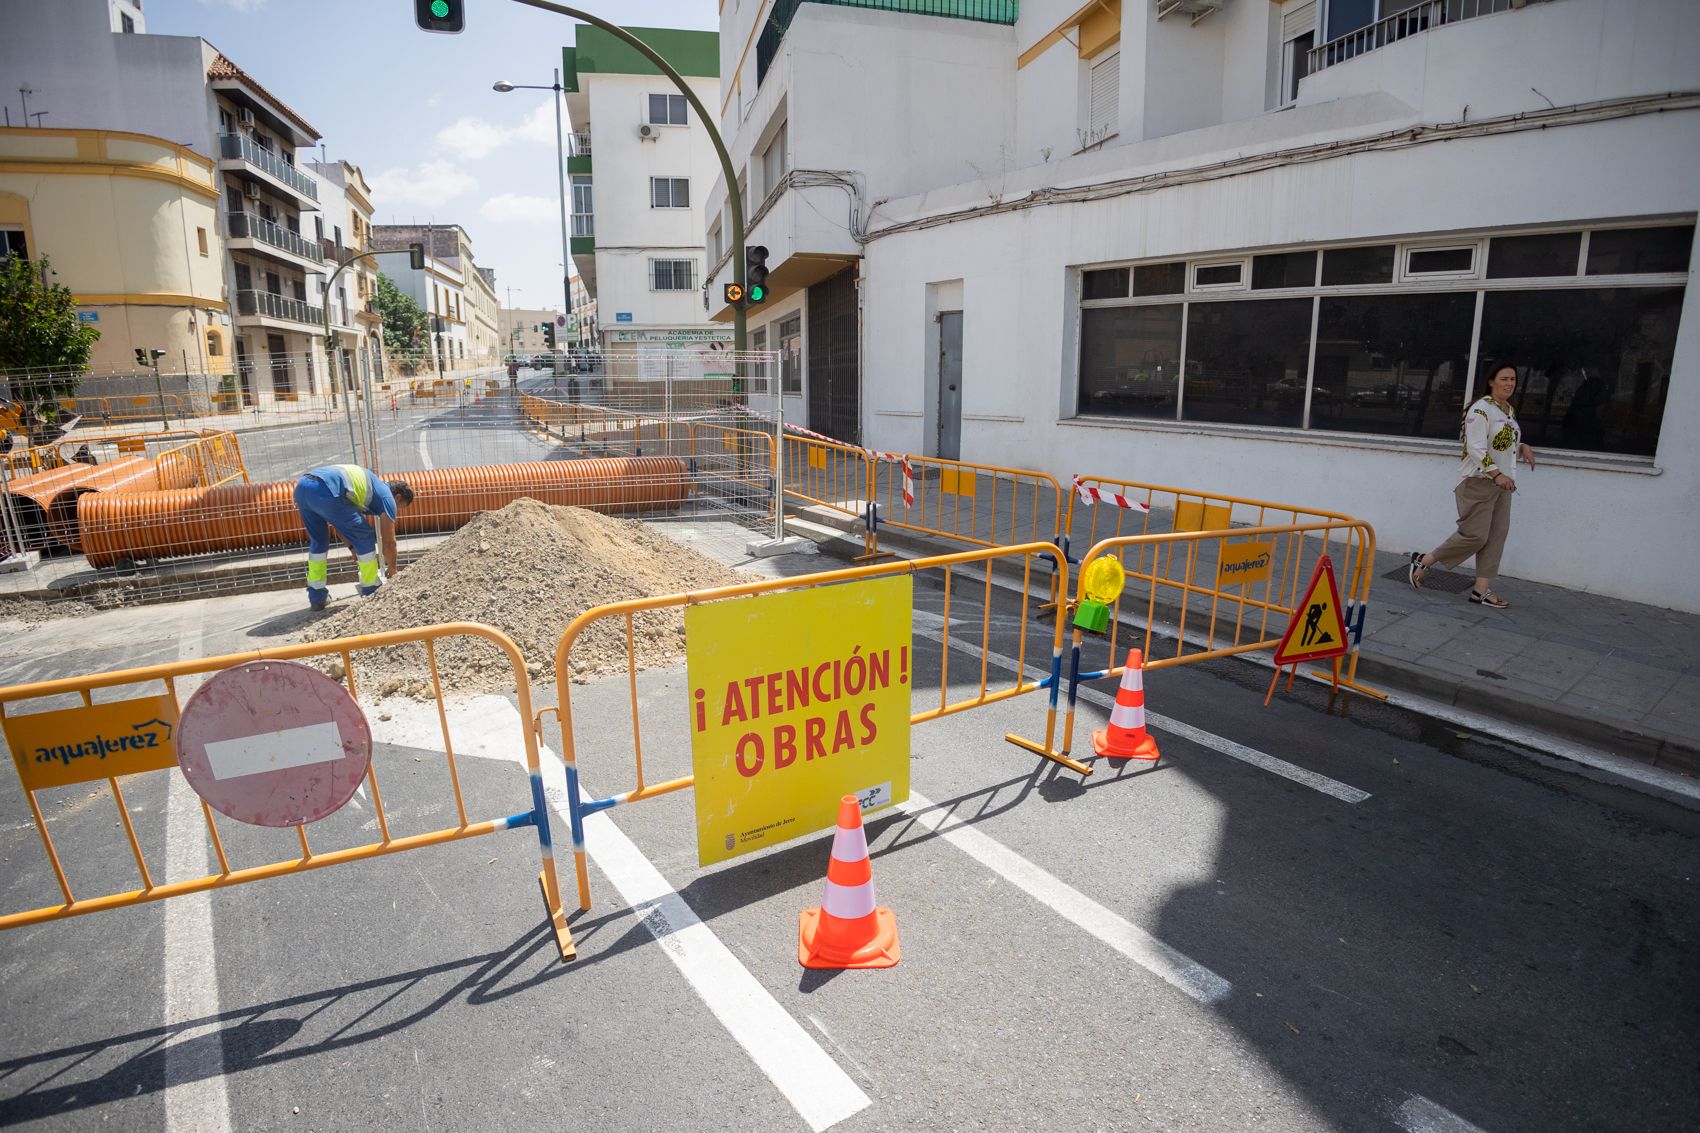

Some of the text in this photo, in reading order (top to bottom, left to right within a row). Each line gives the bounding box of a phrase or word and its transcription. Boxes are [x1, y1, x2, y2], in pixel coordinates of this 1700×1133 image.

[1225, 558, 1265, 574] aquajerez
[34, 731, 159, 767] aquajerez
[735, 703, 878, 778] OBRAS
